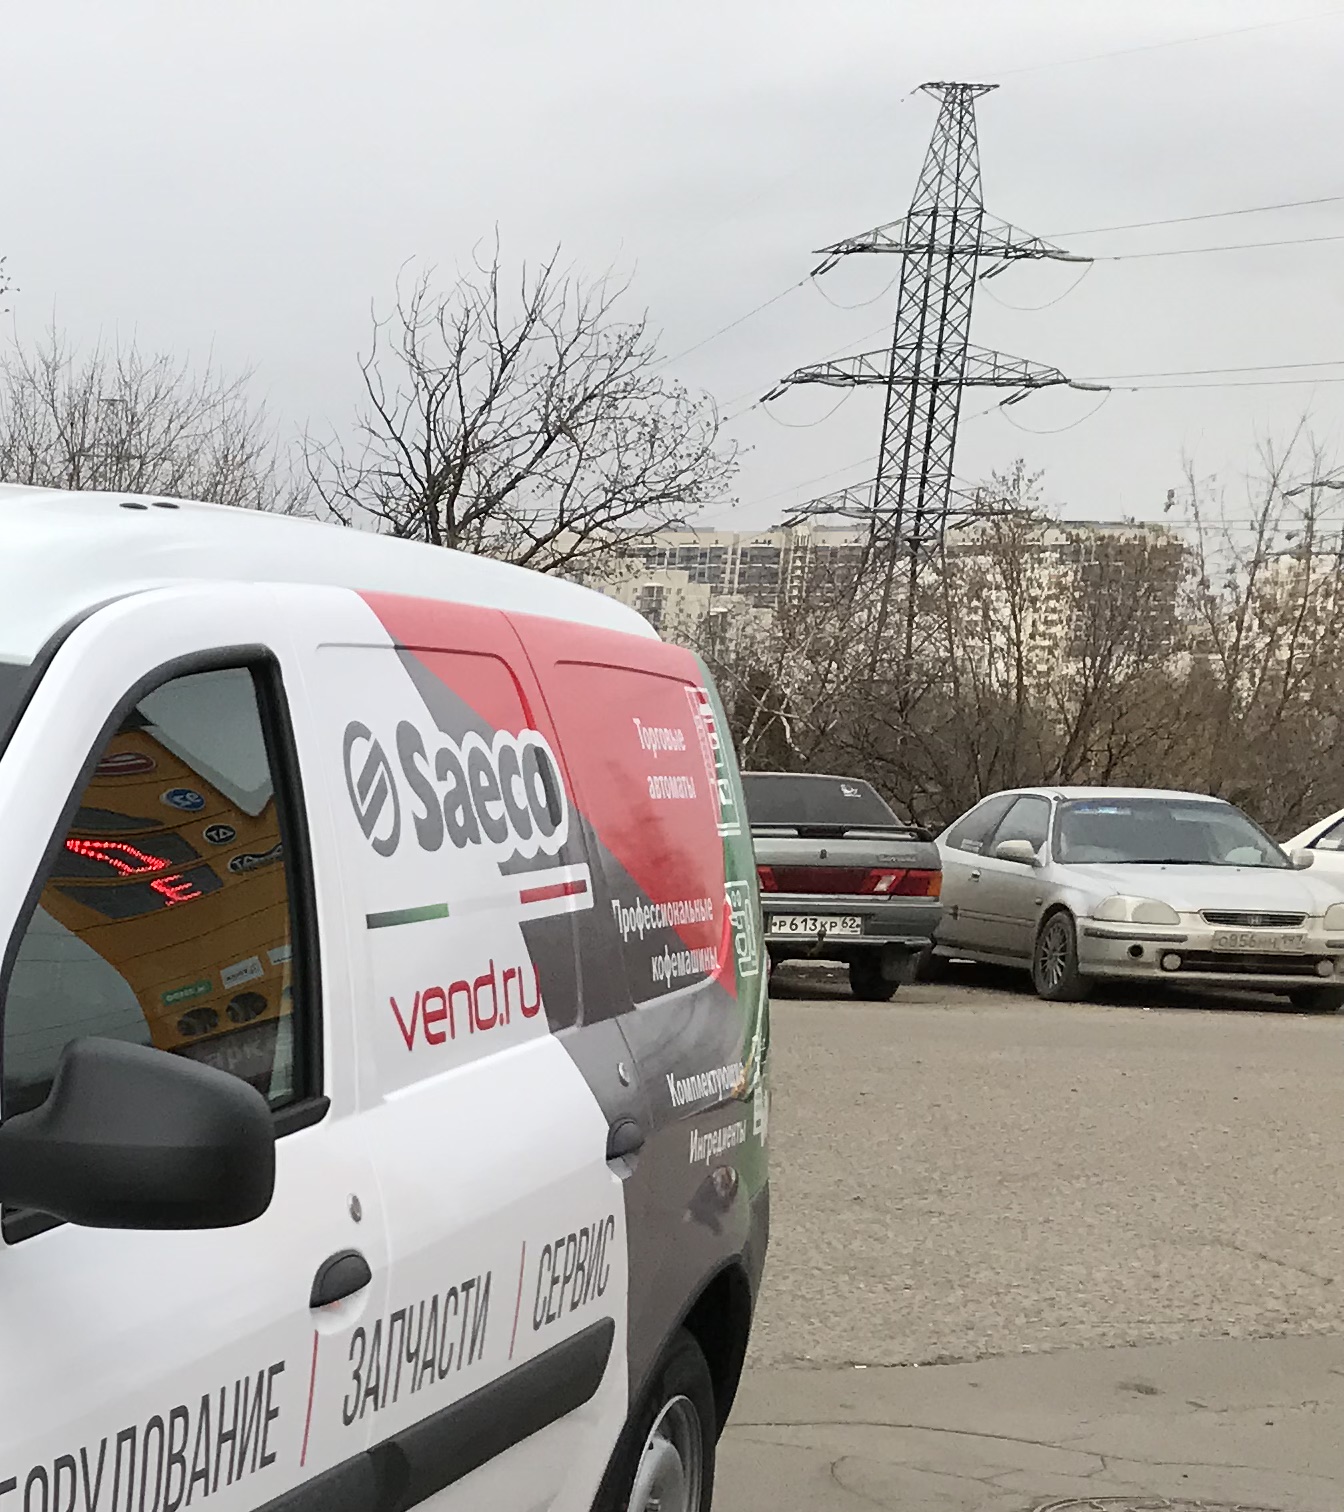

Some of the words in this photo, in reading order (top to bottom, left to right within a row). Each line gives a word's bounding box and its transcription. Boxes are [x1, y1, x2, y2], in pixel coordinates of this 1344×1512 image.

[632, 718, 686, 758] Торговые
[647, 776, 696, 799] автоматы
[611, 897, 713, 942] Профессиональные
[651, 945, 720, 988] кофемашины
[390, 959, 541, 1051] vend.ru
[342, 1271, 493, 1426] ЗАПЧАСТИ
[532, 1214, 615, 1331] СЕРВИС
